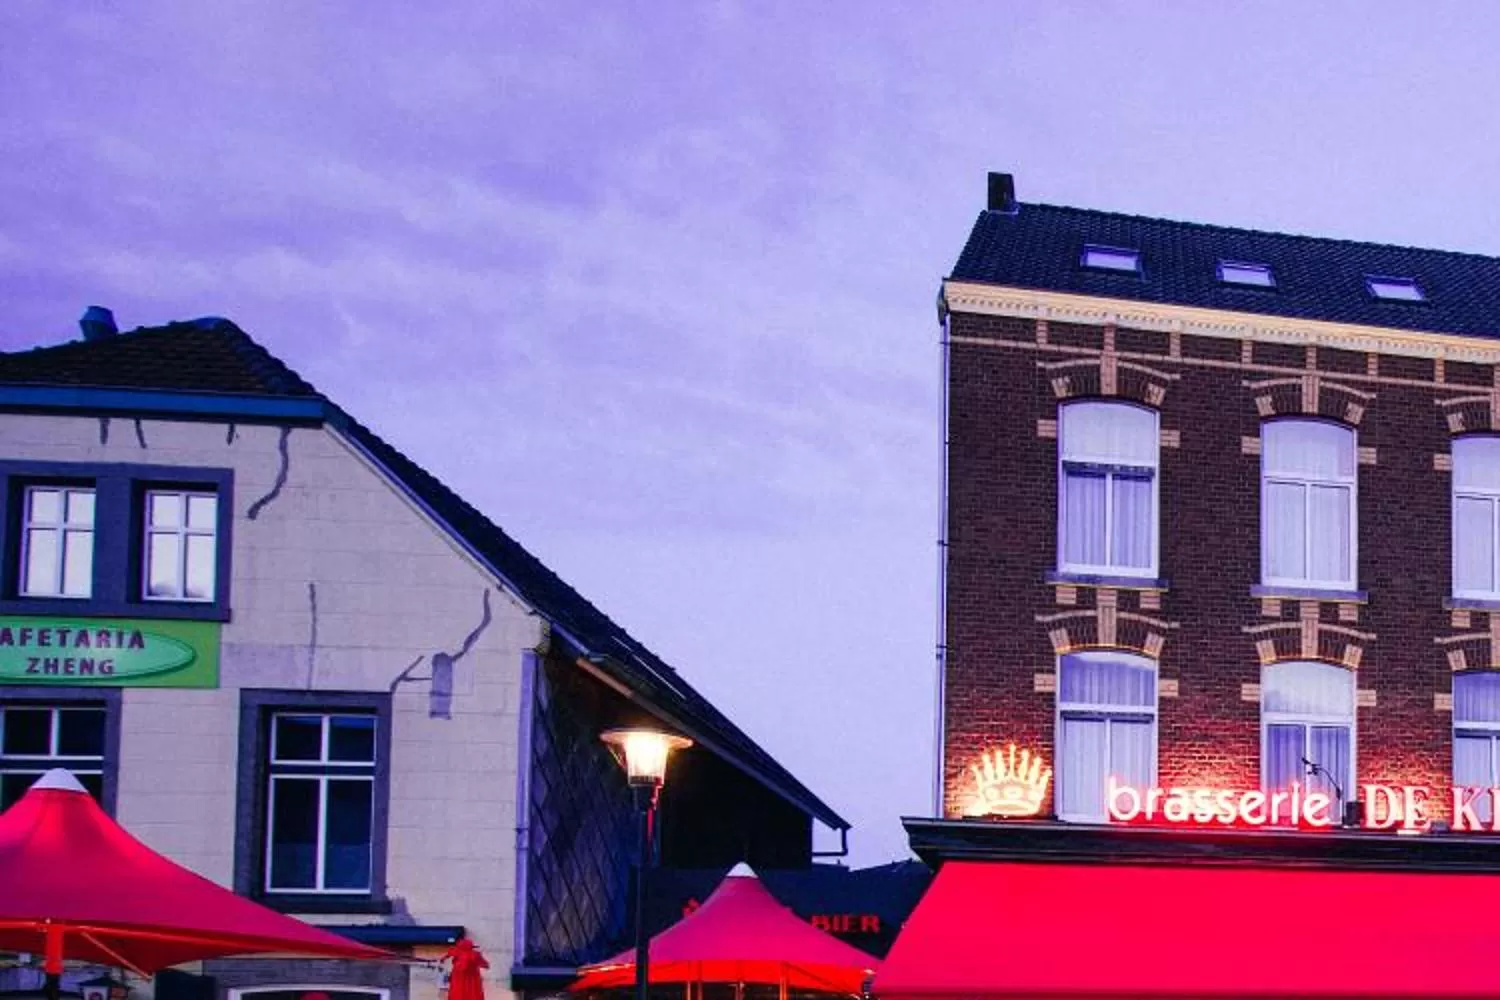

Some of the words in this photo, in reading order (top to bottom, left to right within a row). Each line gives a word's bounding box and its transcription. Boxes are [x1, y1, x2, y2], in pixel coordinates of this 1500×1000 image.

[26, 657, 115, 675] ZHENG
[1108, 775, 1332, 827] brasserie
[1362, 783, 1431, 830] DE
[811, 914, 880, 933] BIER
